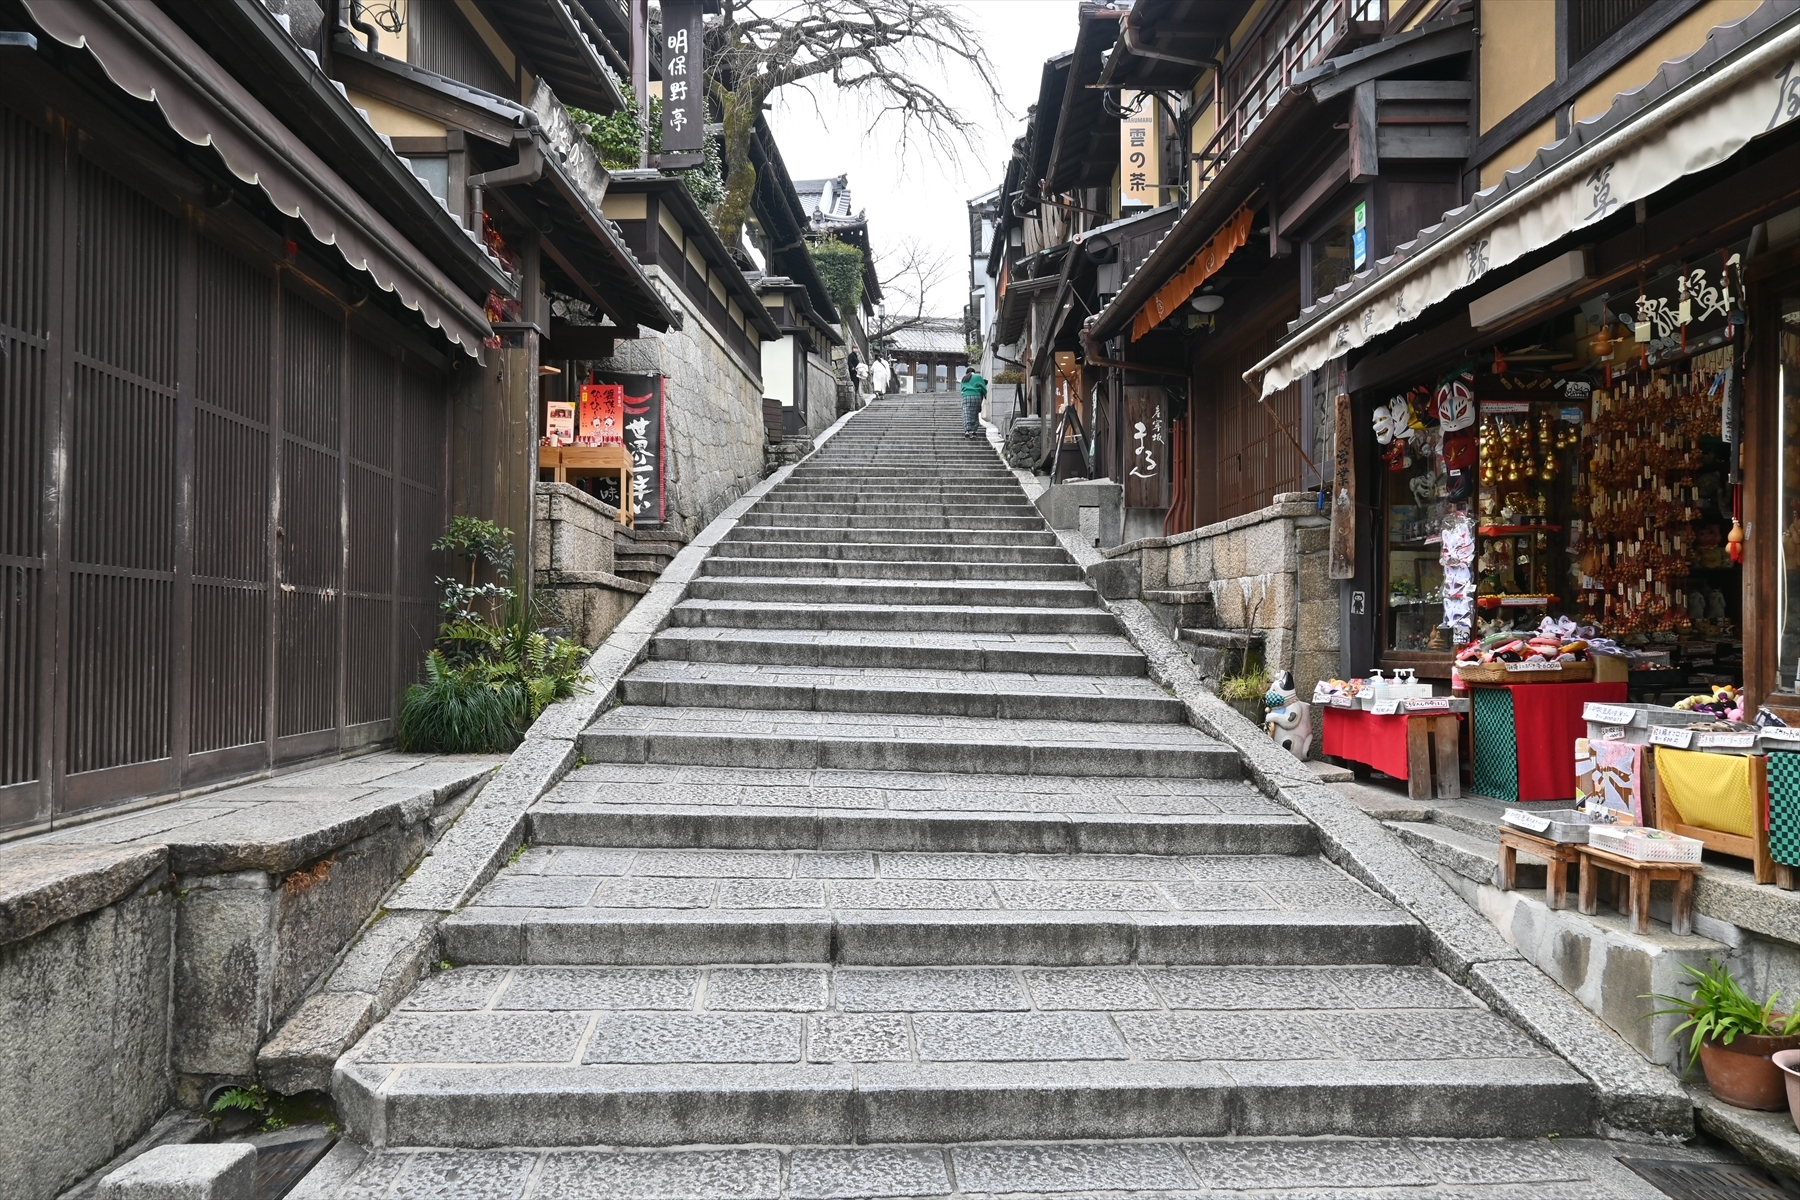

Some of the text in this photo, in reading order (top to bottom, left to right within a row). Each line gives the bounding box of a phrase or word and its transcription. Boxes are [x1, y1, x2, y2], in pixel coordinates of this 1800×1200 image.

[668, 29, 688, 132] 明保野亭
[1129, 128, 1146, 191] 雲の茶
[625, 417, 655, 514] 世界一辛い
